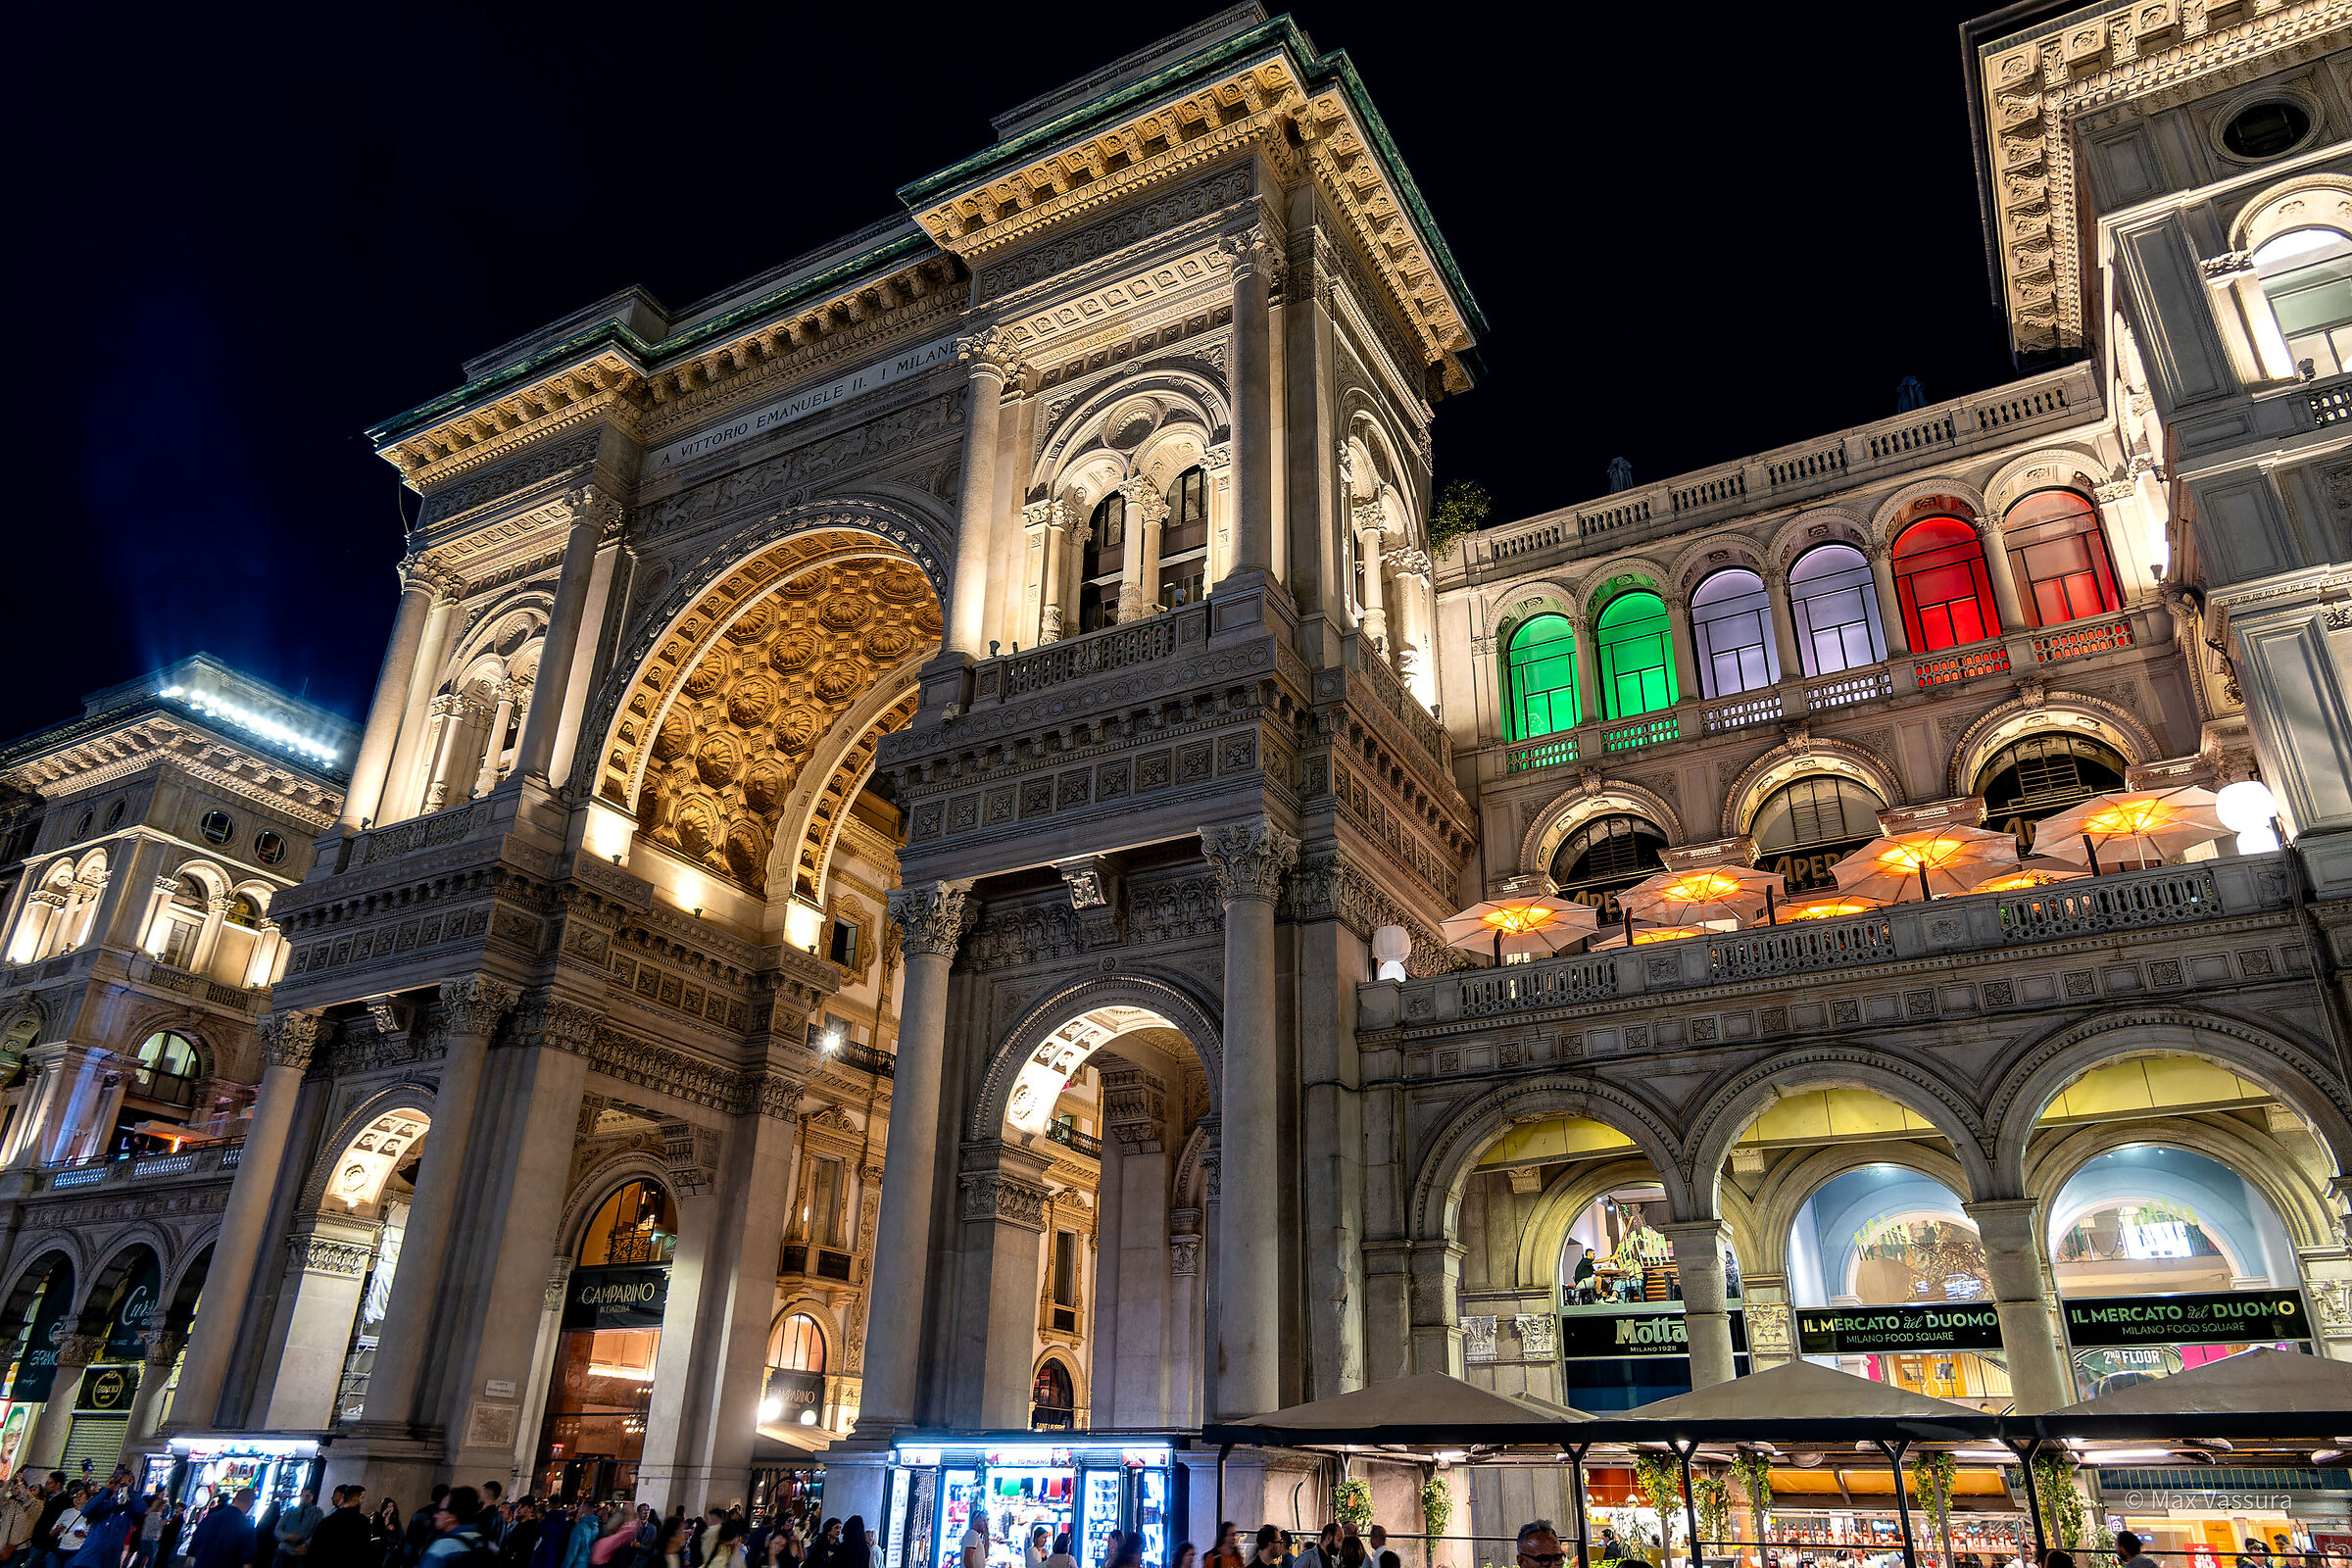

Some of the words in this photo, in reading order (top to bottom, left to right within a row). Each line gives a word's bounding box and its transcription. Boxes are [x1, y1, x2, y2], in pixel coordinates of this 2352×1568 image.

[660, 453, 670, 466] A
[681, 422, 749, 457] VITTORIO
[756, 385, 844, 429] EMANUELE
[896, 340, 957, 374] MILANE
[1774, 850, 1858, 883] APER
[581, 1282, 656, 1305] CAMPARINO
[1803, 1319, 1818, 1333] IL
[1821, 1315, 1900, 1332] MERCATO
[1903, 1316, 1922, 1329] del
[1926, 1312, 1998, 1328] DUOMO
[2071, 1309, 2088, 1323] IL
[2091, 1304, 2182, 1323] MERCATO
[2187, 1303, 2208, 1319] del
[2213, 1300, 2295, 1318] DUOMO
[1615, 1317, 1689, 1345] Motta
[1846, 1334, 1884, 1344] MILANO
[1886, 1333, 1914, 1343] FOOD
[1916, 1332, 1954, 1342] SQUARE
[2123, 1323, 2165, 1335] MILANO
[2167, 1322, 2200, 1334] FOOD
[2202, 1321, 2245, 1333] SQUARE
[2124, 1349, 2160, 1363] FLOOR
